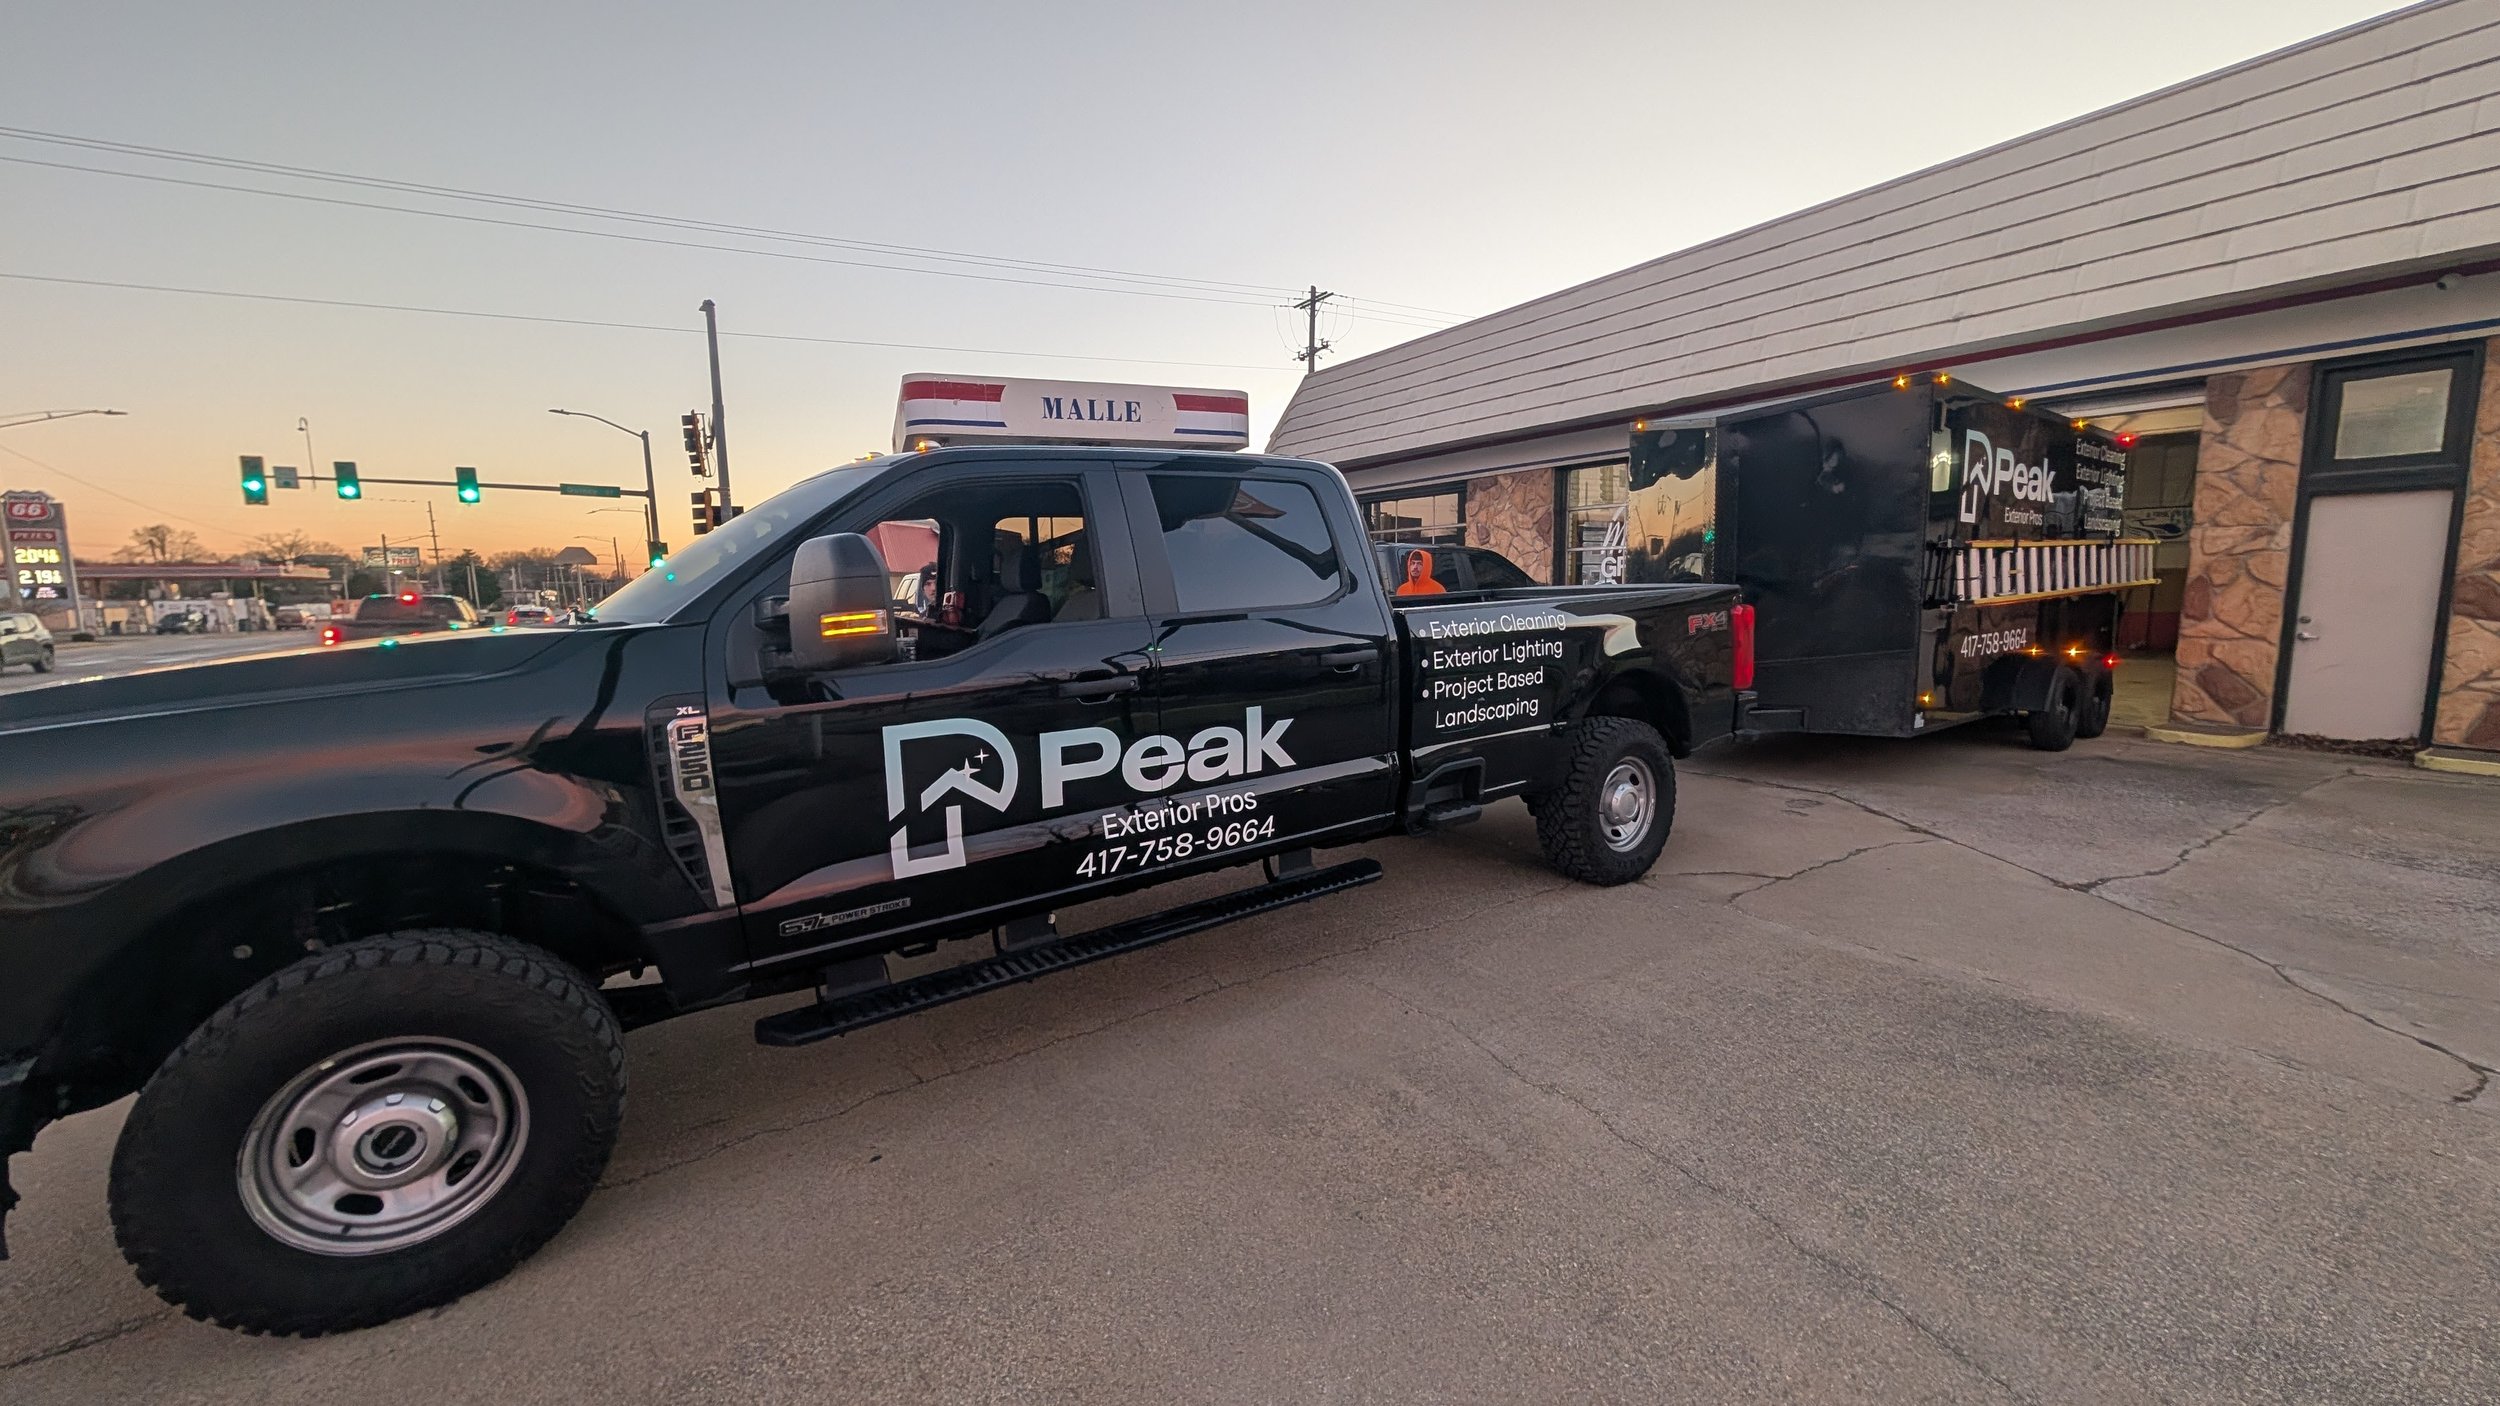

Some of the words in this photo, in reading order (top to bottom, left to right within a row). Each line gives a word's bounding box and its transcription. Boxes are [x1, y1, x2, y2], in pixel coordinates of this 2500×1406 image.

[1041, 396, 1142, 423] MALLE
[1993, 447, 2056, 503] Peak
[12, 503, 42, 516] 66
[2005, 507, 2030, 524] Exterior
[2030, 510, 2043, 526] Pros
[1429, 617, 1496, 640] Exterior
[1500, 611, 1566, 632] Cleaning
[1688, 610, 1728, 635] FX4
[1433, 646, 1499, 670] Exterior
[1503, 638, 1563, 663] Lighting
[1960, 627, 2027, 658] 417-758-9664
[1434, 674, 1494, 700] Project
[1497, 665, 1544, 691] Based
[676, 706, 700, 716] XL
[1435, 697, 1539, 729] Landscaping
[1039, 705, 1297, 810] Peak
[1102, 800, 1201, 840] Exterior
[1205, 791, 1258, 819] Pros
[1076, 815, 1275, 878] 417-758-9664
[831, 908, 868, 924] POWER
[869, 898, 910, 914] STROKE
